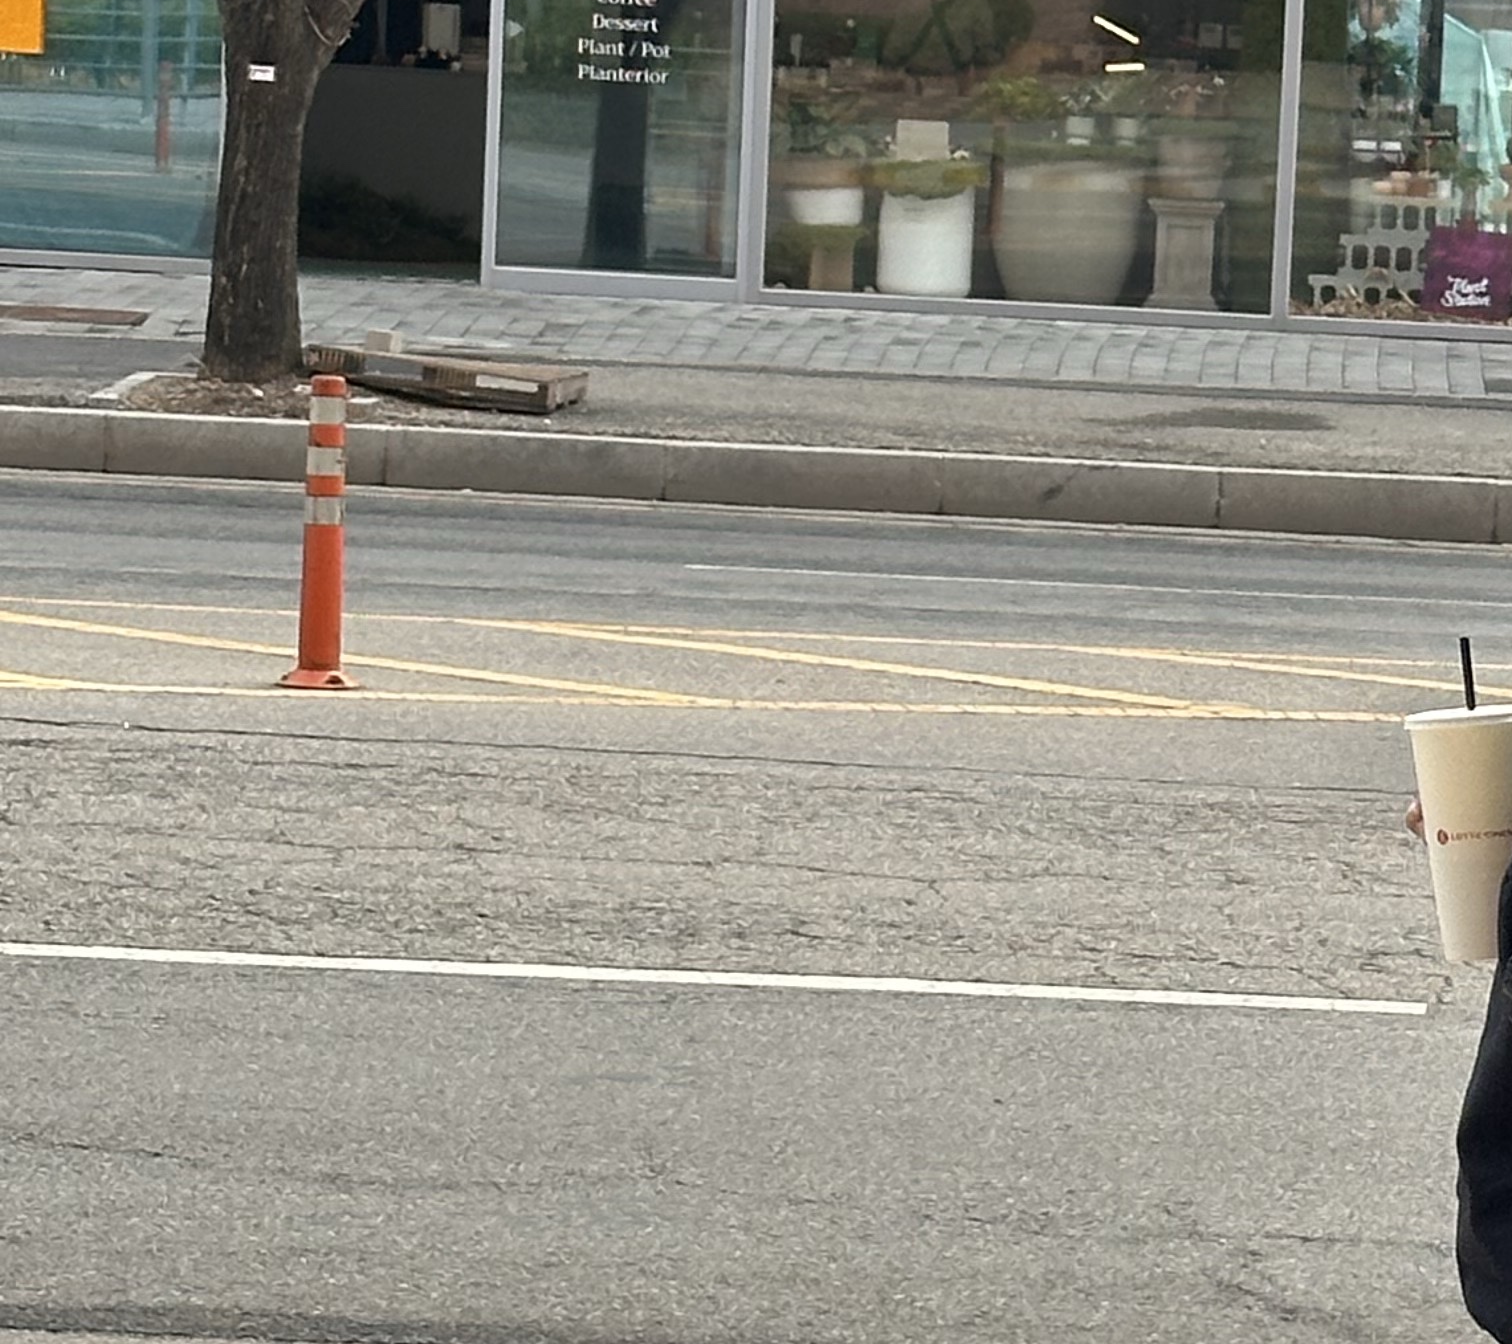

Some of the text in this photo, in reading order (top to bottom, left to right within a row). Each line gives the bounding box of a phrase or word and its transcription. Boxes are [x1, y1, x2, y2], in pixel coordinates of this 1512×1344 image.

[592, 13, 659, 33] Dessert
[578, 37, 625, 57] Plant
[642, 41, 671, 59] Pot
[578, 63, 669, 85] Planterior
